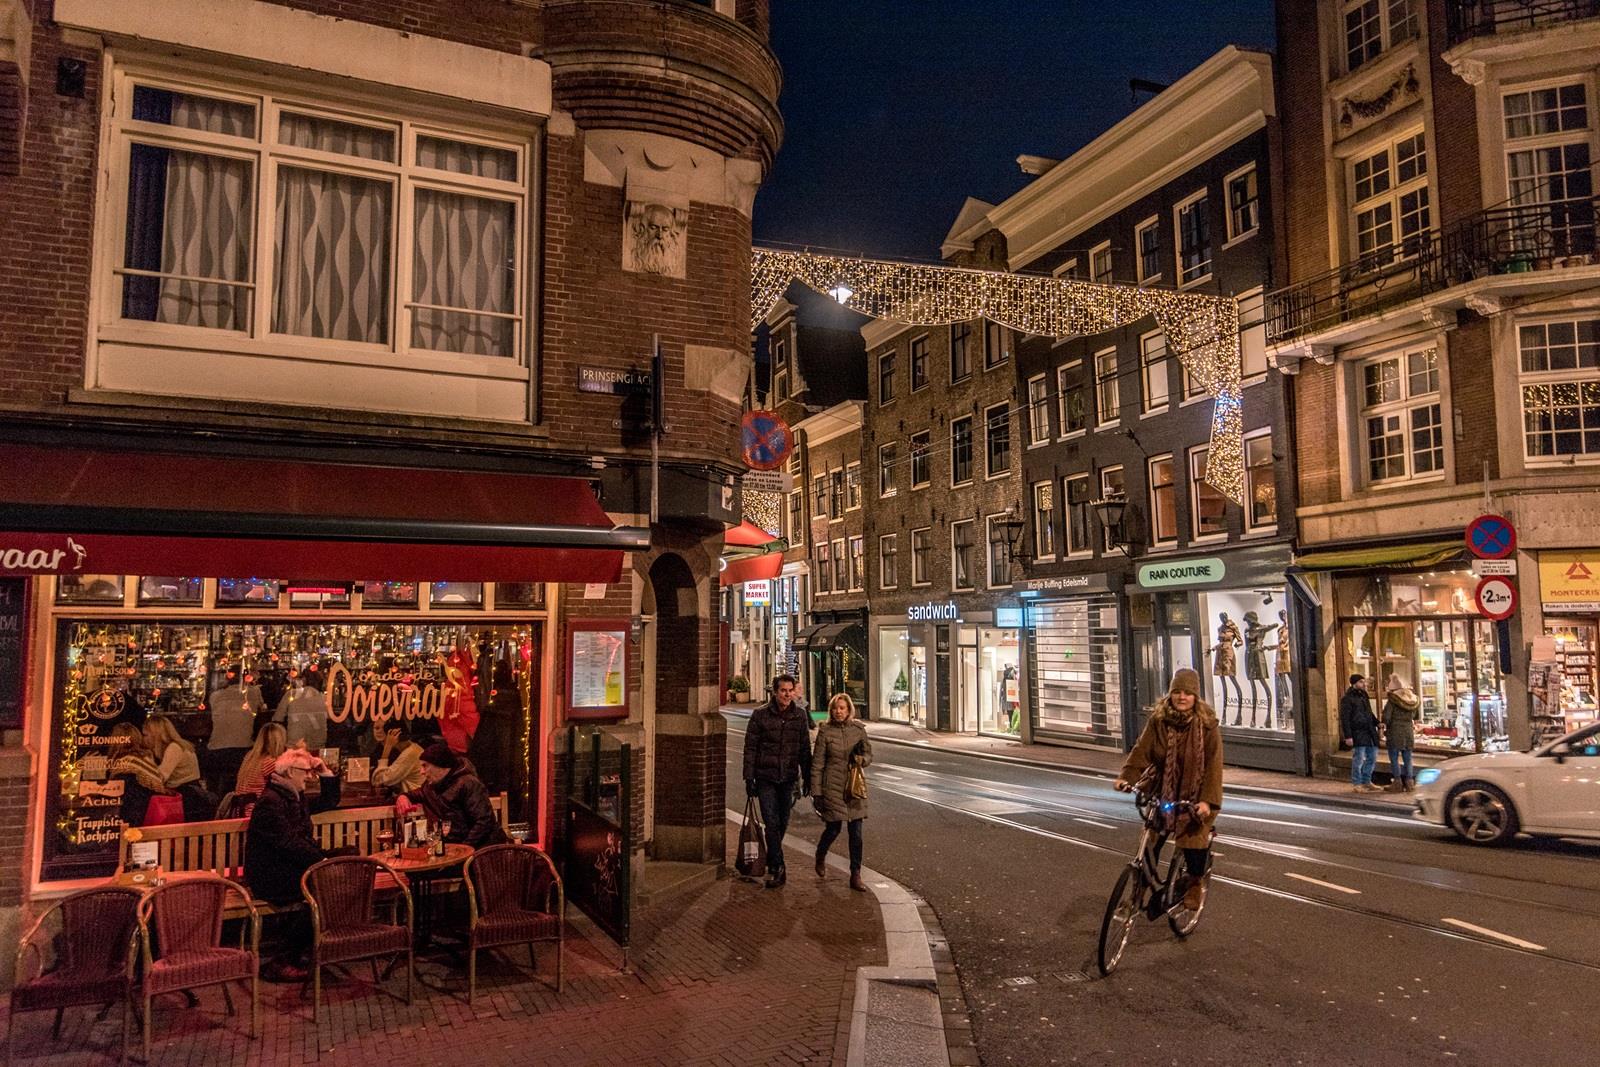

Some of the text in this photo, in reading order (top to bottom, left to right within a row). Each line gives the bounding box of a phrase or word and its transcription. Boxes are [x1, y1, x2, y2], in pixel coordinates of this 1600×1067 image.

[583, 369, 651, 385] PRINSENGAC
[1149, 566, 1211, 580] RAIN COUTURE
[326, 662, 450, 724] Ooievaar
[77, 735, 131, 746] DE KONINCK
